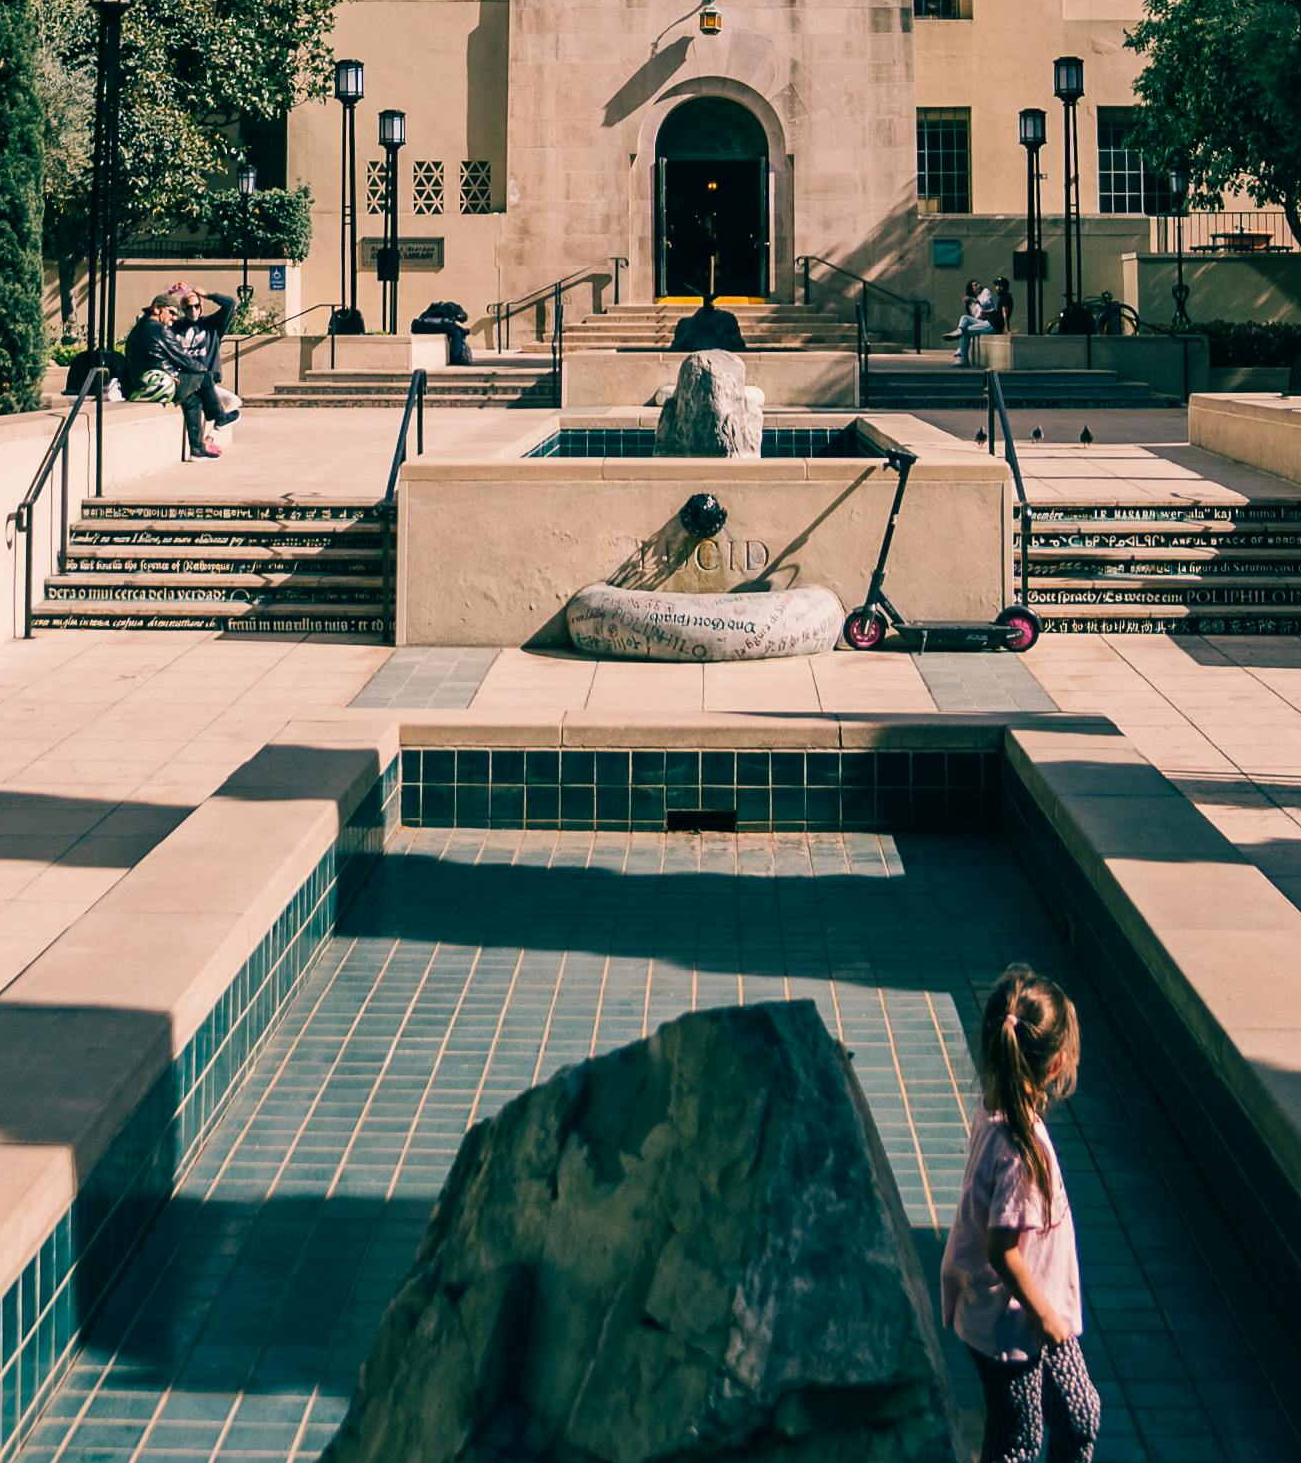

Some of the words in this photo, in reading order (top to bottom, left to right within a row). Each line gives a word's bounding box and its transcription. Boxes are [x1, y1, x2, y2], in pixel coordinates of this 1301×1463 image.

[1171, 537, 1207, 546] AWFUL
[1250, 537, 1264, 545] OF
[639, 538, 771, 572] LUCID
